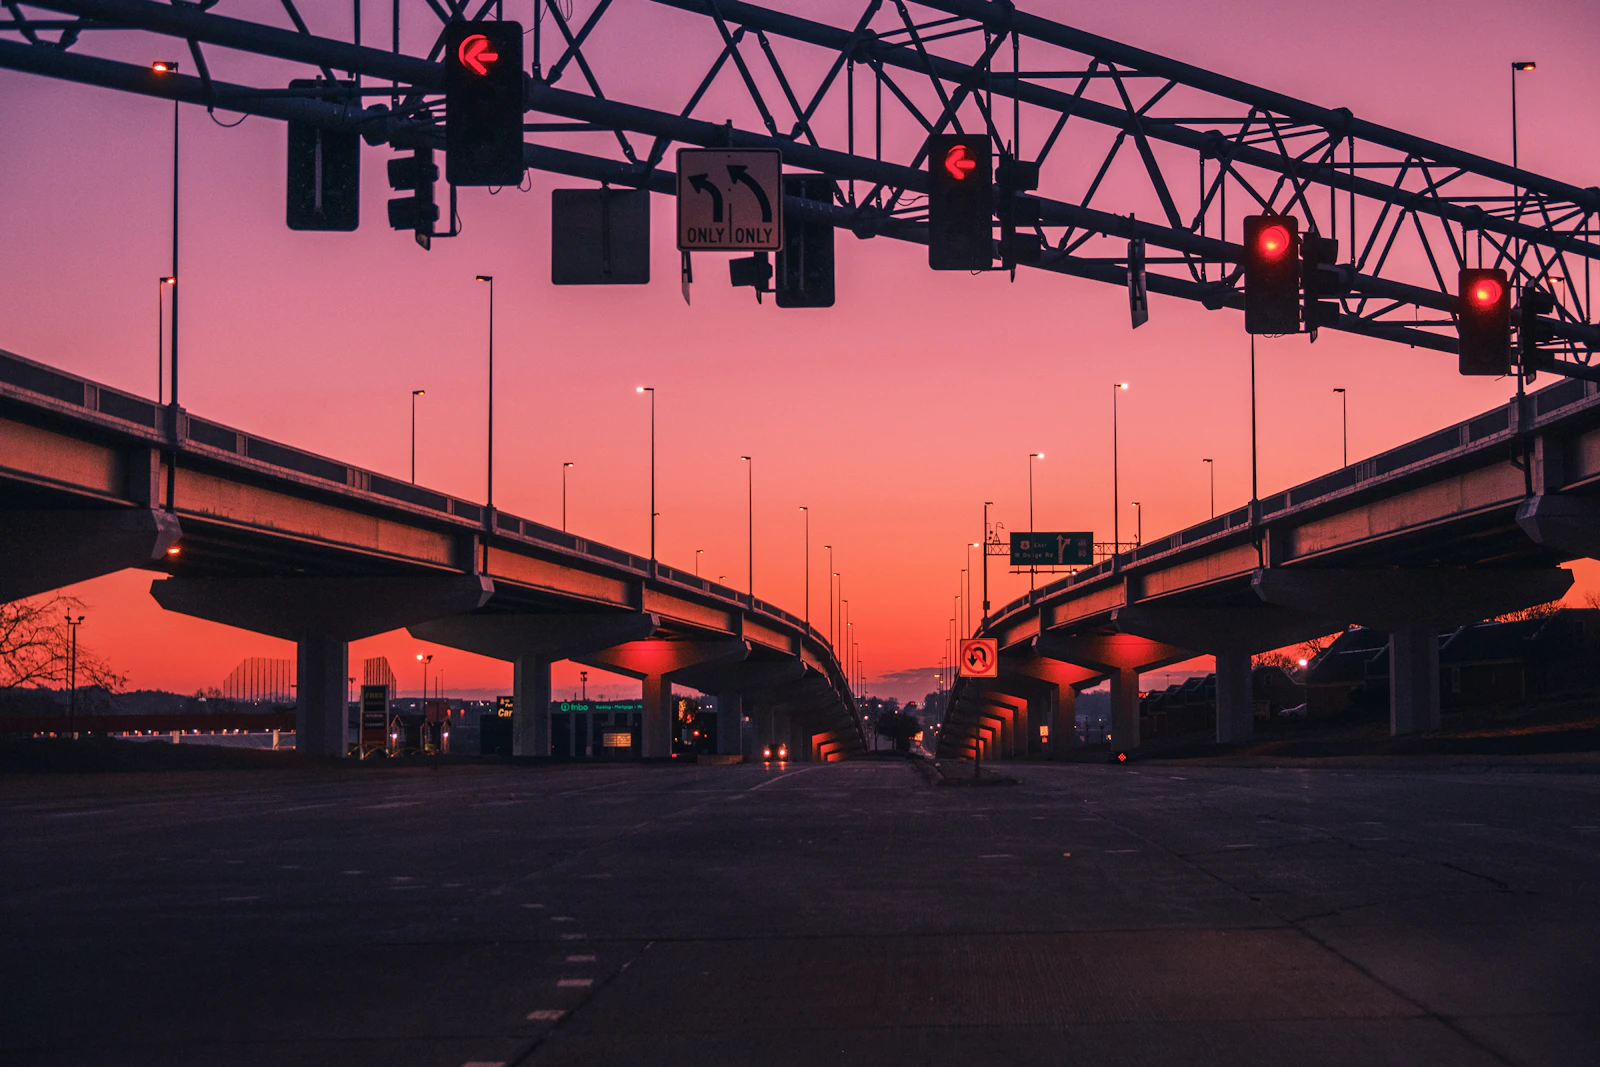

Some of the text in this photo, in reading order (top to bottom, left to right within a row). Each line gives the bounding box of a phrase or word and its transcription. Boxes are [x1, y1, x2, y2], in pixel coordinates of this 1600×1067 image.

[687, 227, 725, 243] ONLY
[735, 227, 772, 243] ONLY
[497, 708, 514, 718] Car
[571, 703, 589, 711] fnbo
